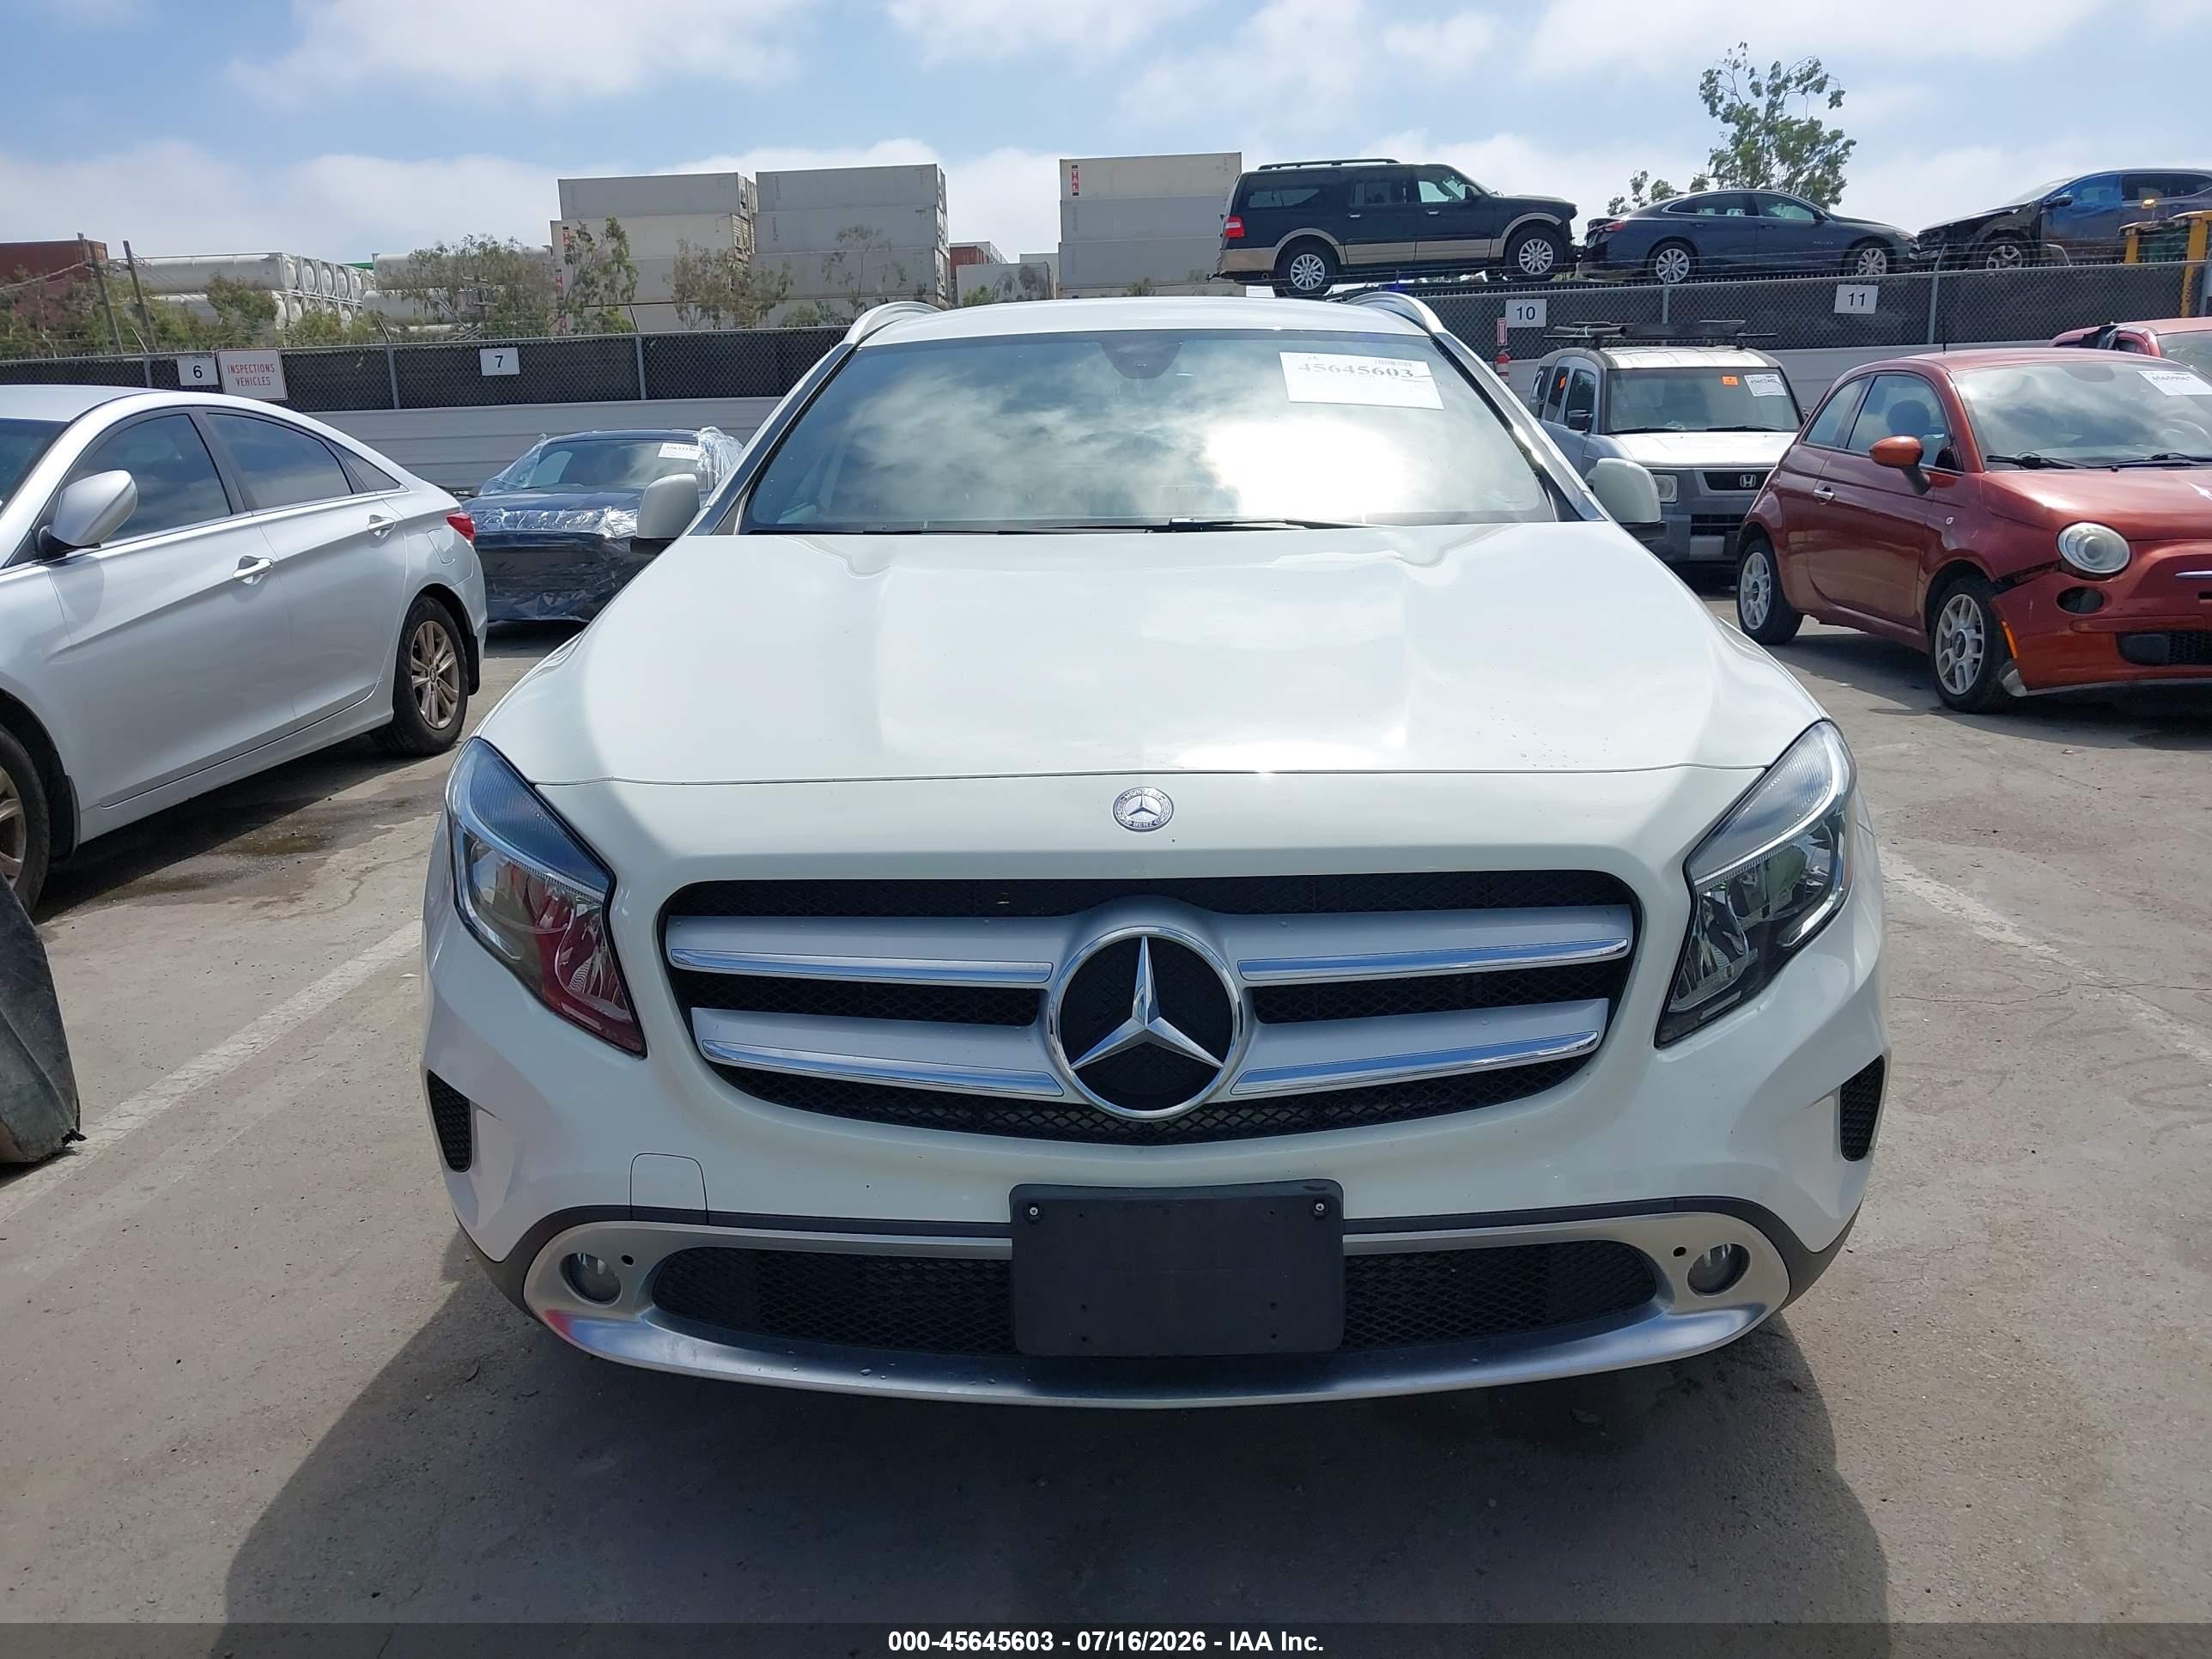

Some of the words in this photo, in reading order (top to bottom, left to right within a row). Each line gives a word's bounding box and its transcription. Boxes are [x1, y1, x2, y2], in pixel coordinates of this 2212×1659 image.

[1848, 292, 1865, 307] 11
[1516, 306, 1536, 320] 10
[227, 363, 276, 374] INSPECTIONS
[494, 355, 504, 368] 7
[192, 365, 203, 379] 6
[1297, 362, 1414, 379] 45645603
[235, 376, 271, 386] VEHICLES
